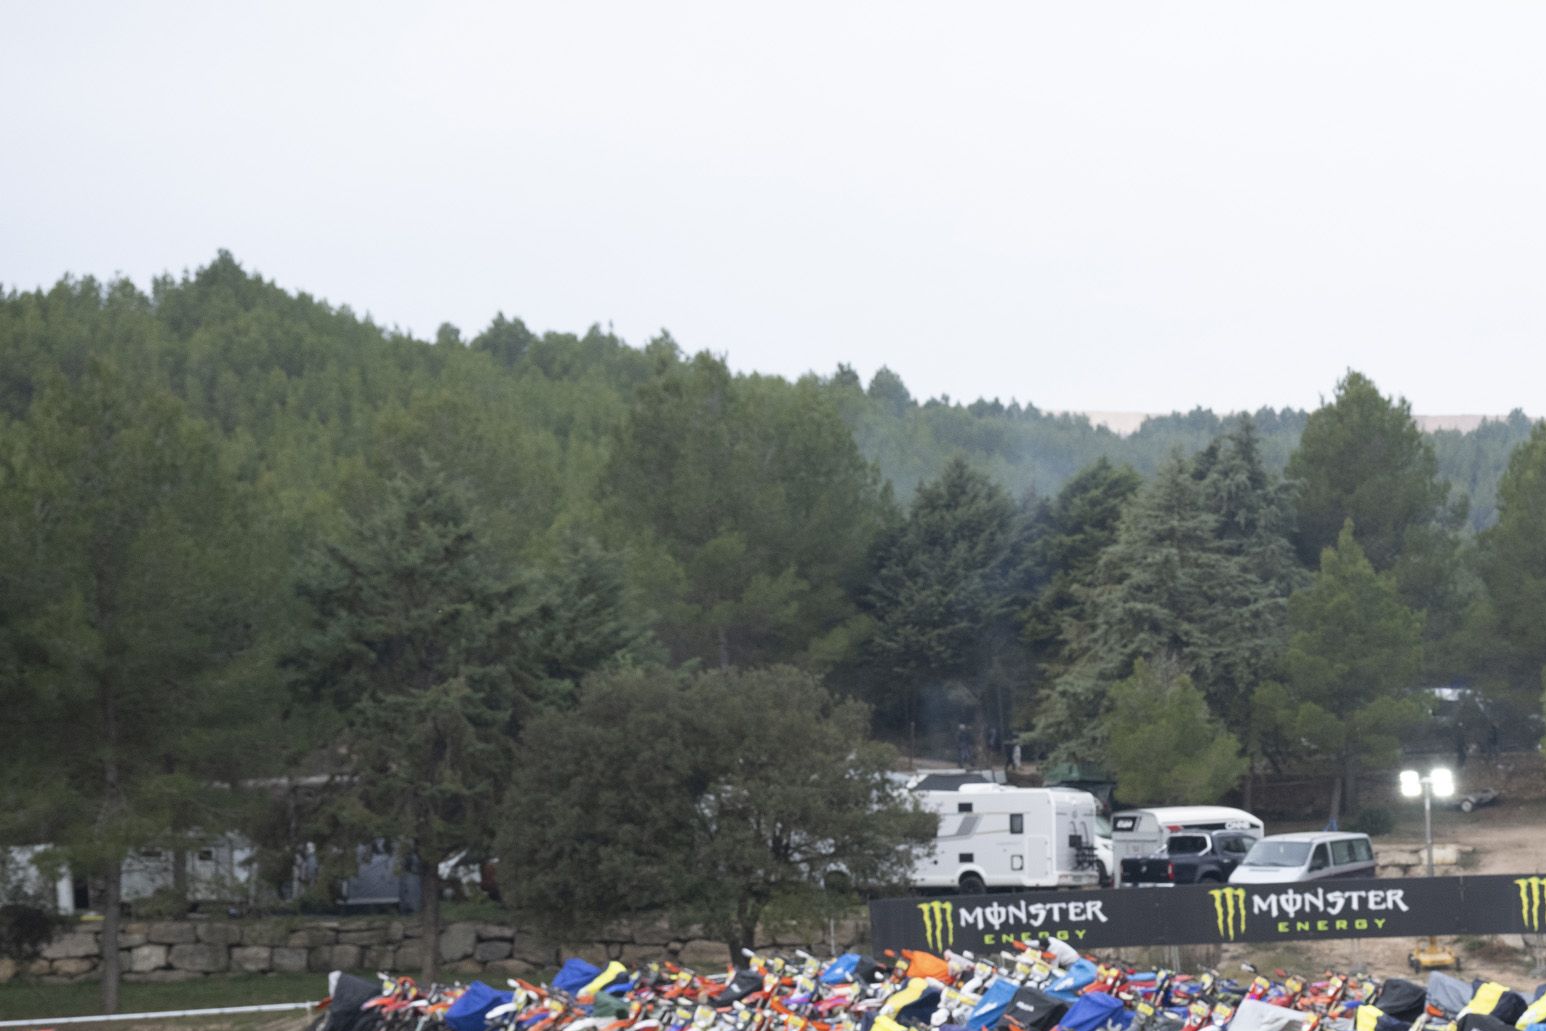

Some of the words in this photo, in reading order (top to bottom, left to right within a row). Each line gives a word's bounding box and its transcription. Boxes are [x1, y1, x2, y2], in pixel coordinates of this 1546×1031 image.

[959, 900, 1108, 930] MONSTER
[1252, 887, 1409, 918] MONSTER
[1277, 918, 1387, 932] ENERGY
